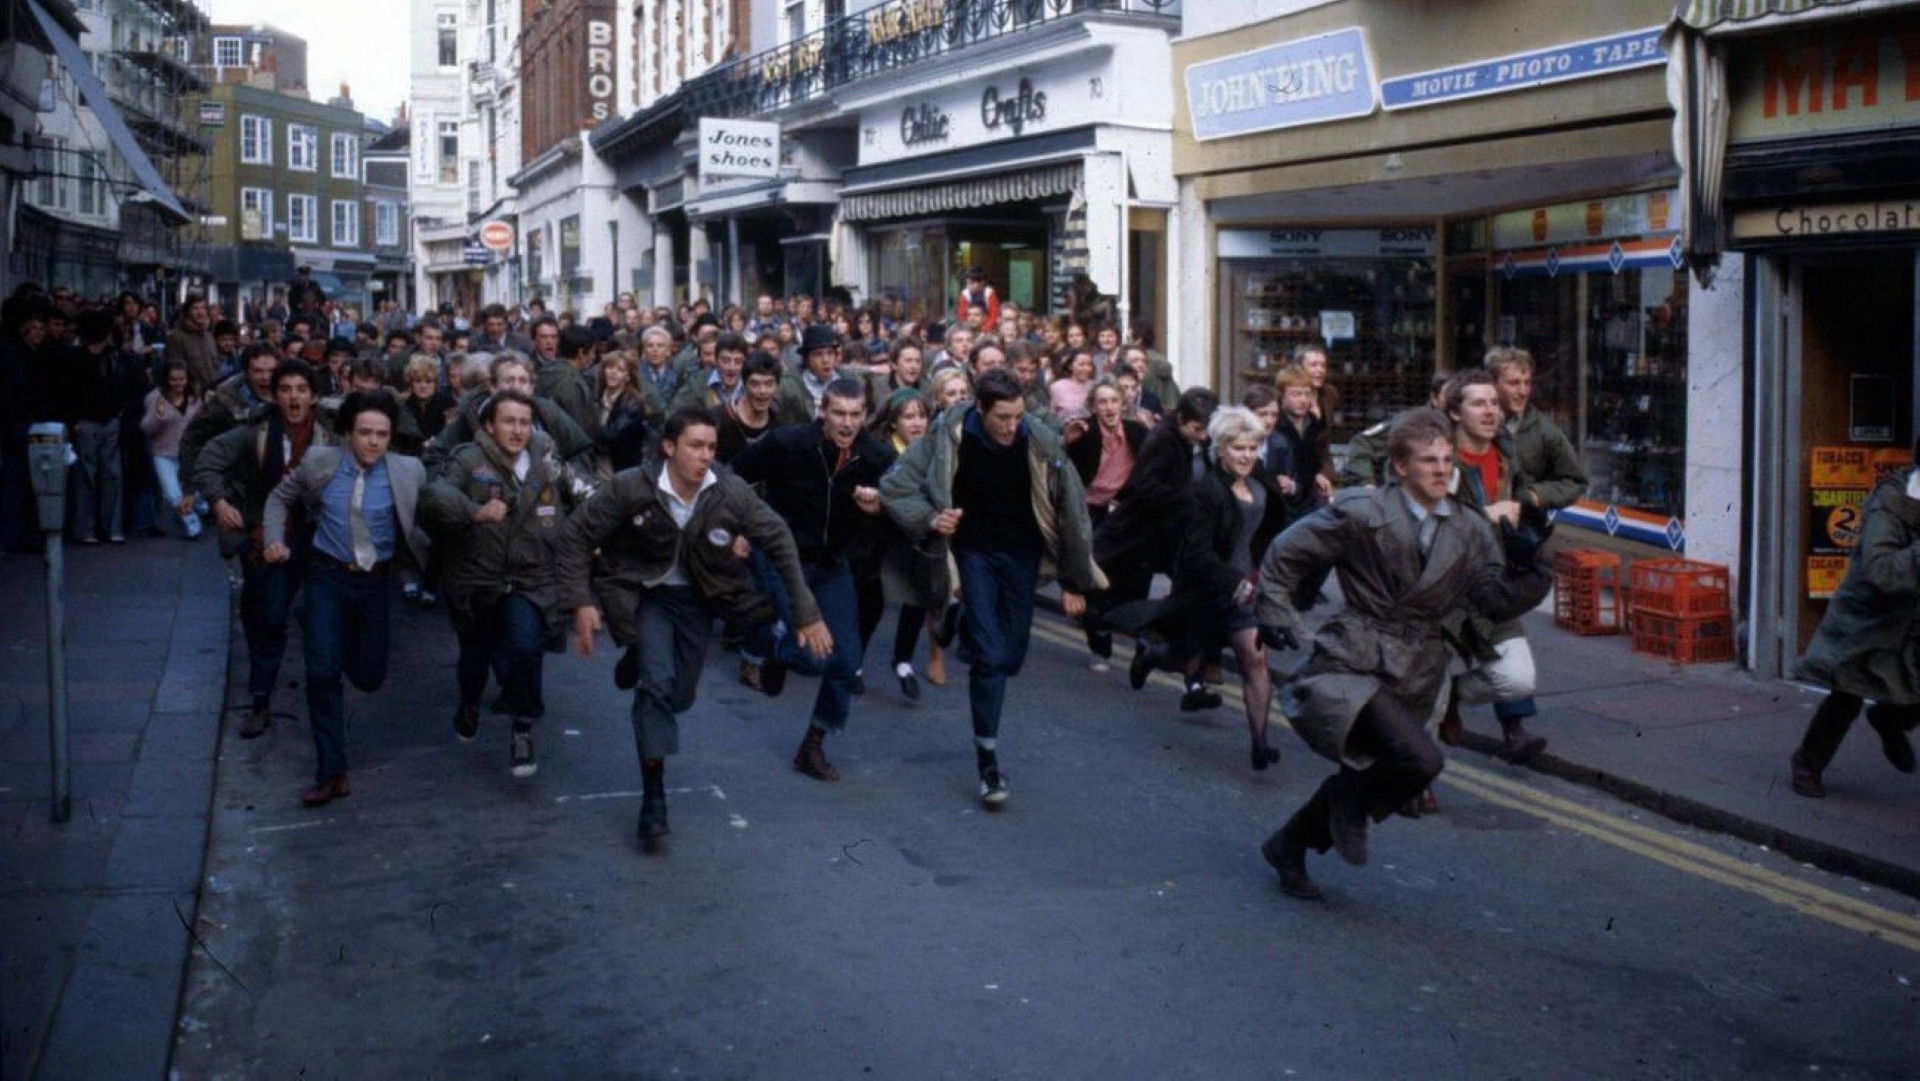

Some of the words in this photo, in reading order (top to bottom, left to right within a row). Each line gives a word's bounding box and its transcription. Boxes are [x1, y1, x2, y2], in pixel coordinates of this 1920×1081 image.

[589, 21, 612, 120] BROS
[1412, 71, 1477, 98] MOVIE
[1495, 53, 1572, 83] PHOTO
[1592, 36, 1659, 66] TAPE
[1197, 70, 1267, 119] JOHN
[1274, 52, 1359, 104] KING
[901, 102, 950, 147] Celtic
[980, 76, 1048, 137] Crafts
[708, 129, 773, 148] Jones
[710, 150, 772, 168] shoes
[1776, 201, 1920, 234] Chocolat
[1269, 230, 1323, 243] SONY
[1379, 229, 1434, 243] SONY
[1835, 508, 1856, 532] 2
